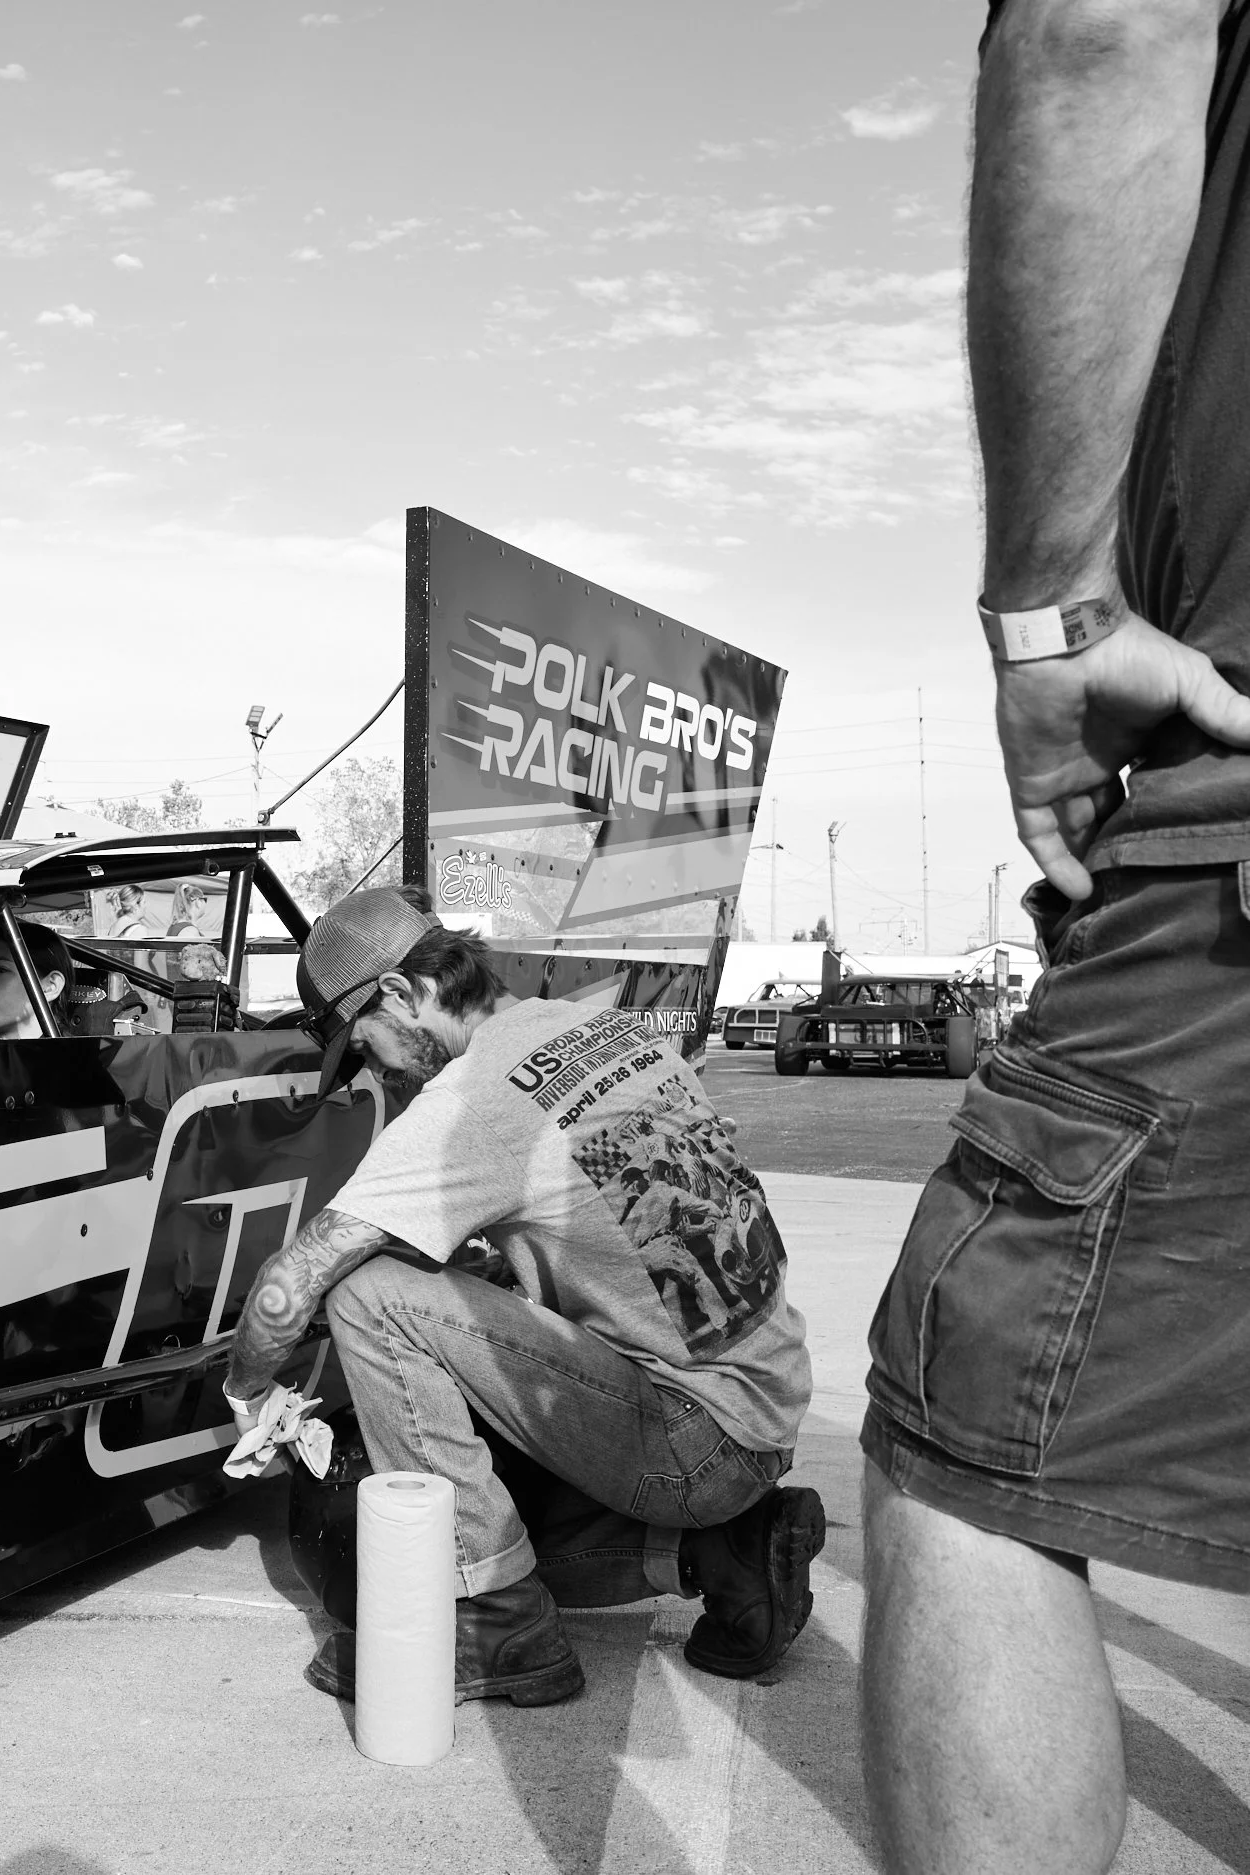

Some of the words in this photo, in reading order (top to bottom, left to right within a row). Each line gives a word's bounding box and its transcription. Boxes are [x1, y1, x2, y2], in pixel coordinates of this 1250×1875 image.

[452, 617, 636, 734] POLK
[640, 681, 758, 771] BRO'S
[440, 700, 668, 812] RACING
[440, 854, 513, 910] Ezell's
[509, 1052, 562, 1093] US
[558, 1015, 639, 1062] CHAMPIONSH
[543, 1030, 584, 1055] ROAD
[656, 1011, 697, 1032] NIGHTS
[535, 1064, 590, 1112] RIVERSIDE
[581, 1035, 641, 1072] INTERNATIONAL
[557, 1090, 597, 1130] april
[594, 1067, 631, 1096] 25/26
[630, 1050, 663, 1072] 1964
